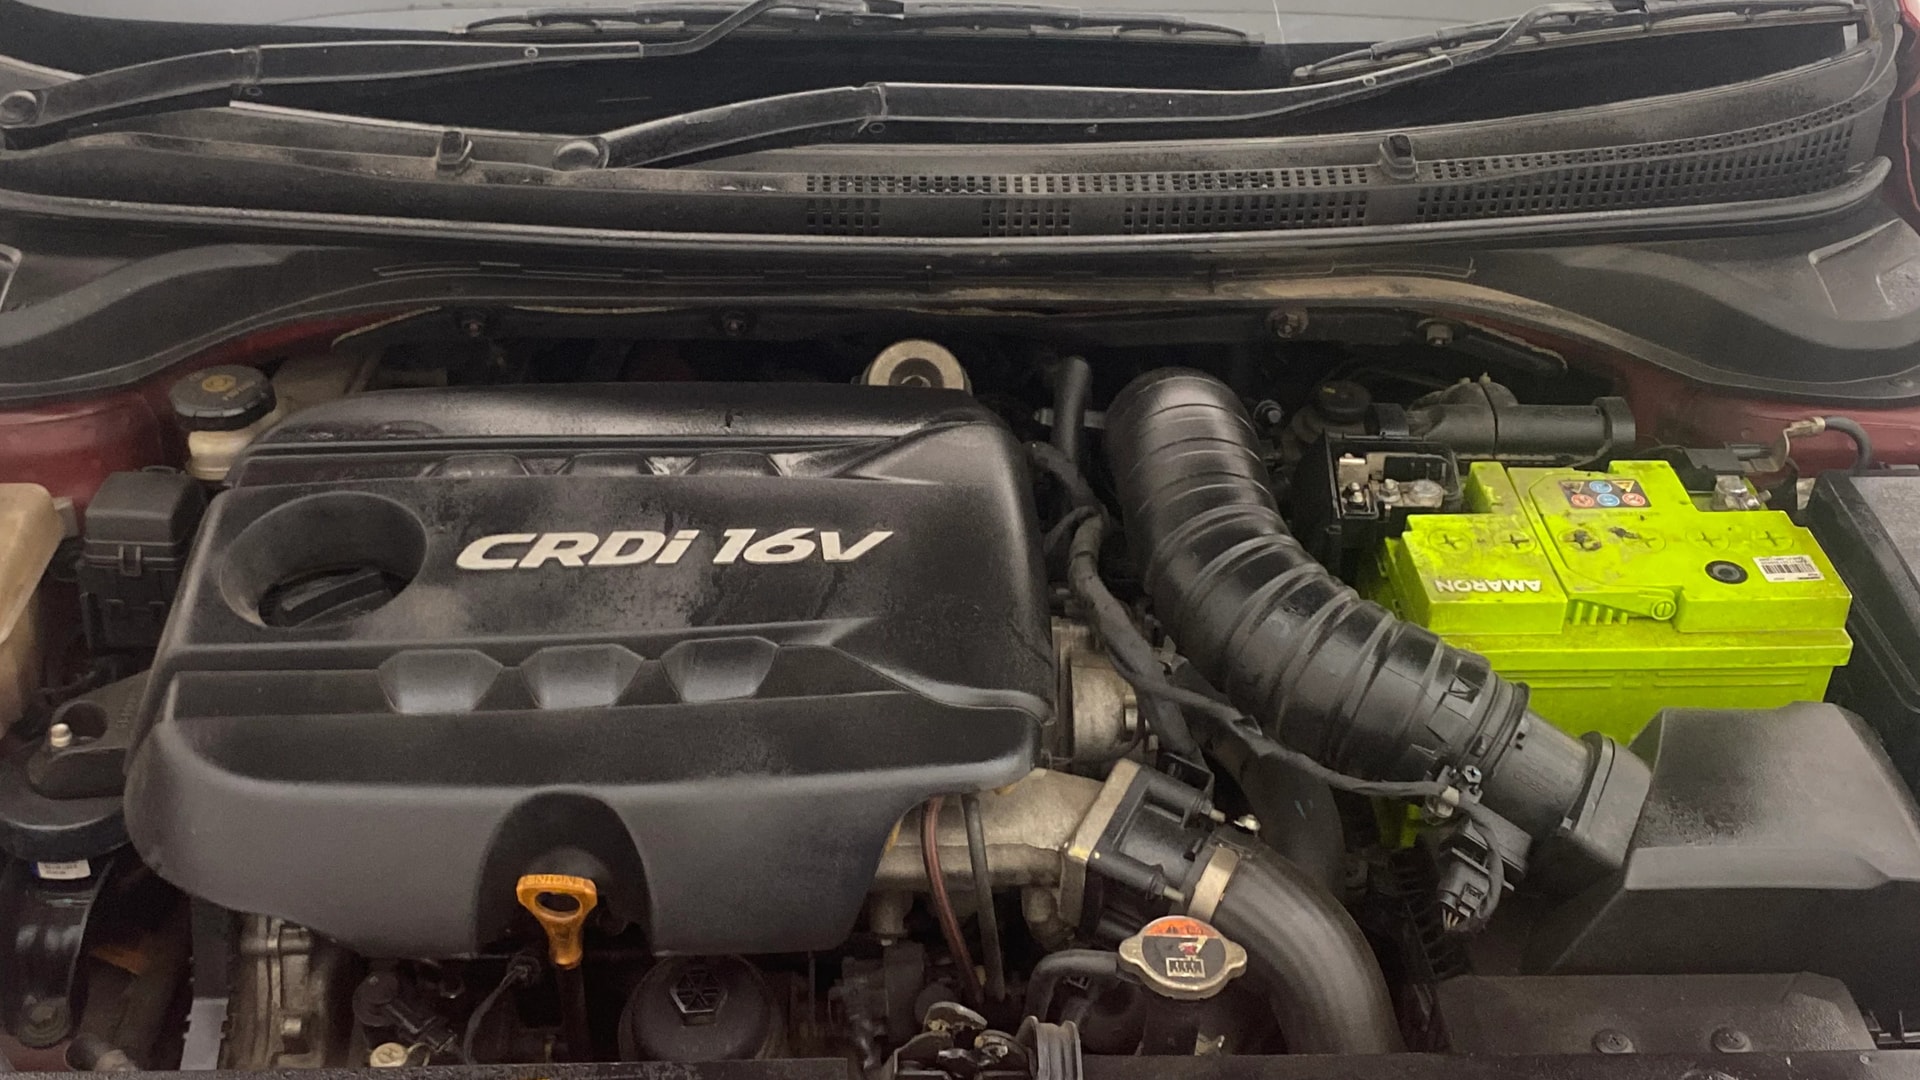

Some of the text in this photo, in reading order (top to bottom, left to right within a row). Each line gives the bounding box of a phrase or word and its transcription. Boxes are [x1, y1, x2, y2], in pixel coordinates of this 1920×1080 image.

[456, 527, 895, 570] CRDi 16V
[1434, 579, 1541, 592] AMARON
